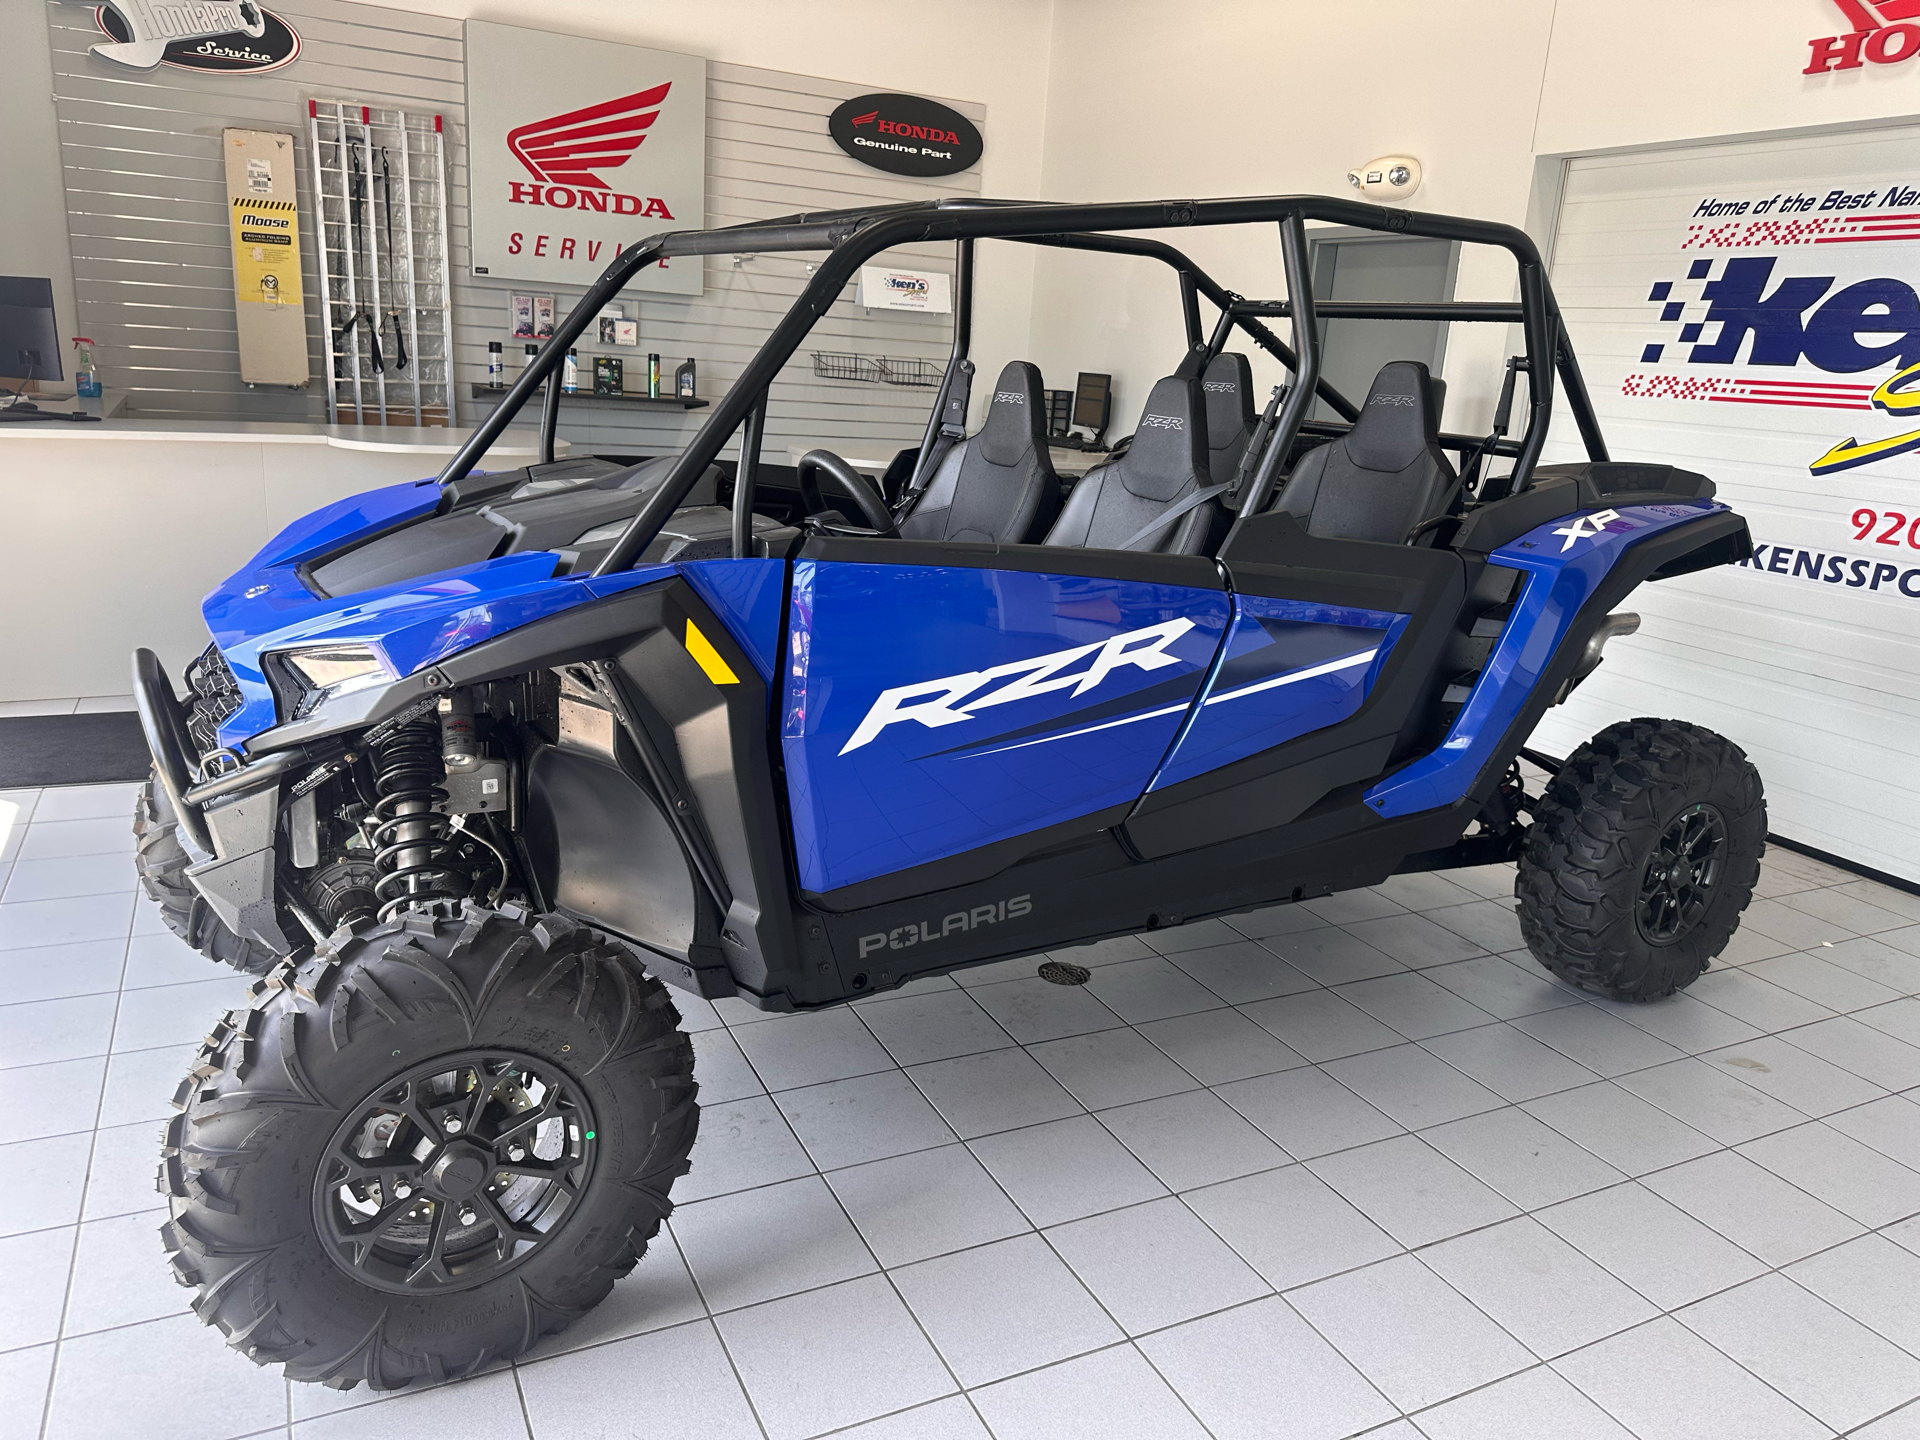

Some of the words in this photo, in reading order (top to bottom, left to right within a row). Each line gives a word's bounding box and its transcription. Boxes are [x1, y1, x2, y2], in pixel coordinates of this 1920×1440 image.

[196, 41, 274, 63] Service
[1802, 23, 1920, 75] HO
[877, 119, 961, 145] HONDA
[853, 136, 918, 154] Genuine
[921, 147, 952, 160] Part
[508, 181, 675, 220] HONDA
[1692, 198, 1750, 218] Home
[1752, 194, 1782, 215] of
[1778, 192, 1817, 214] the
[1817, 190, 1878, 211] Best
[241, 214, 290, 228] Moose
[508, 232, 671, 269] SERVIE
[1687, 256, 1920, 374] ke
[994, 391, 1024, 405] RZR
[1203, 381, 1236, 393] RZR
[1369, 393, 1416, 407] RZR
[1142, 413, 1183, 430] RZR
[1551, 508, 1621, 554] XP
[837, 616, 1196, 757] RZR
[858, 894, 1033, 959] POLARIS
